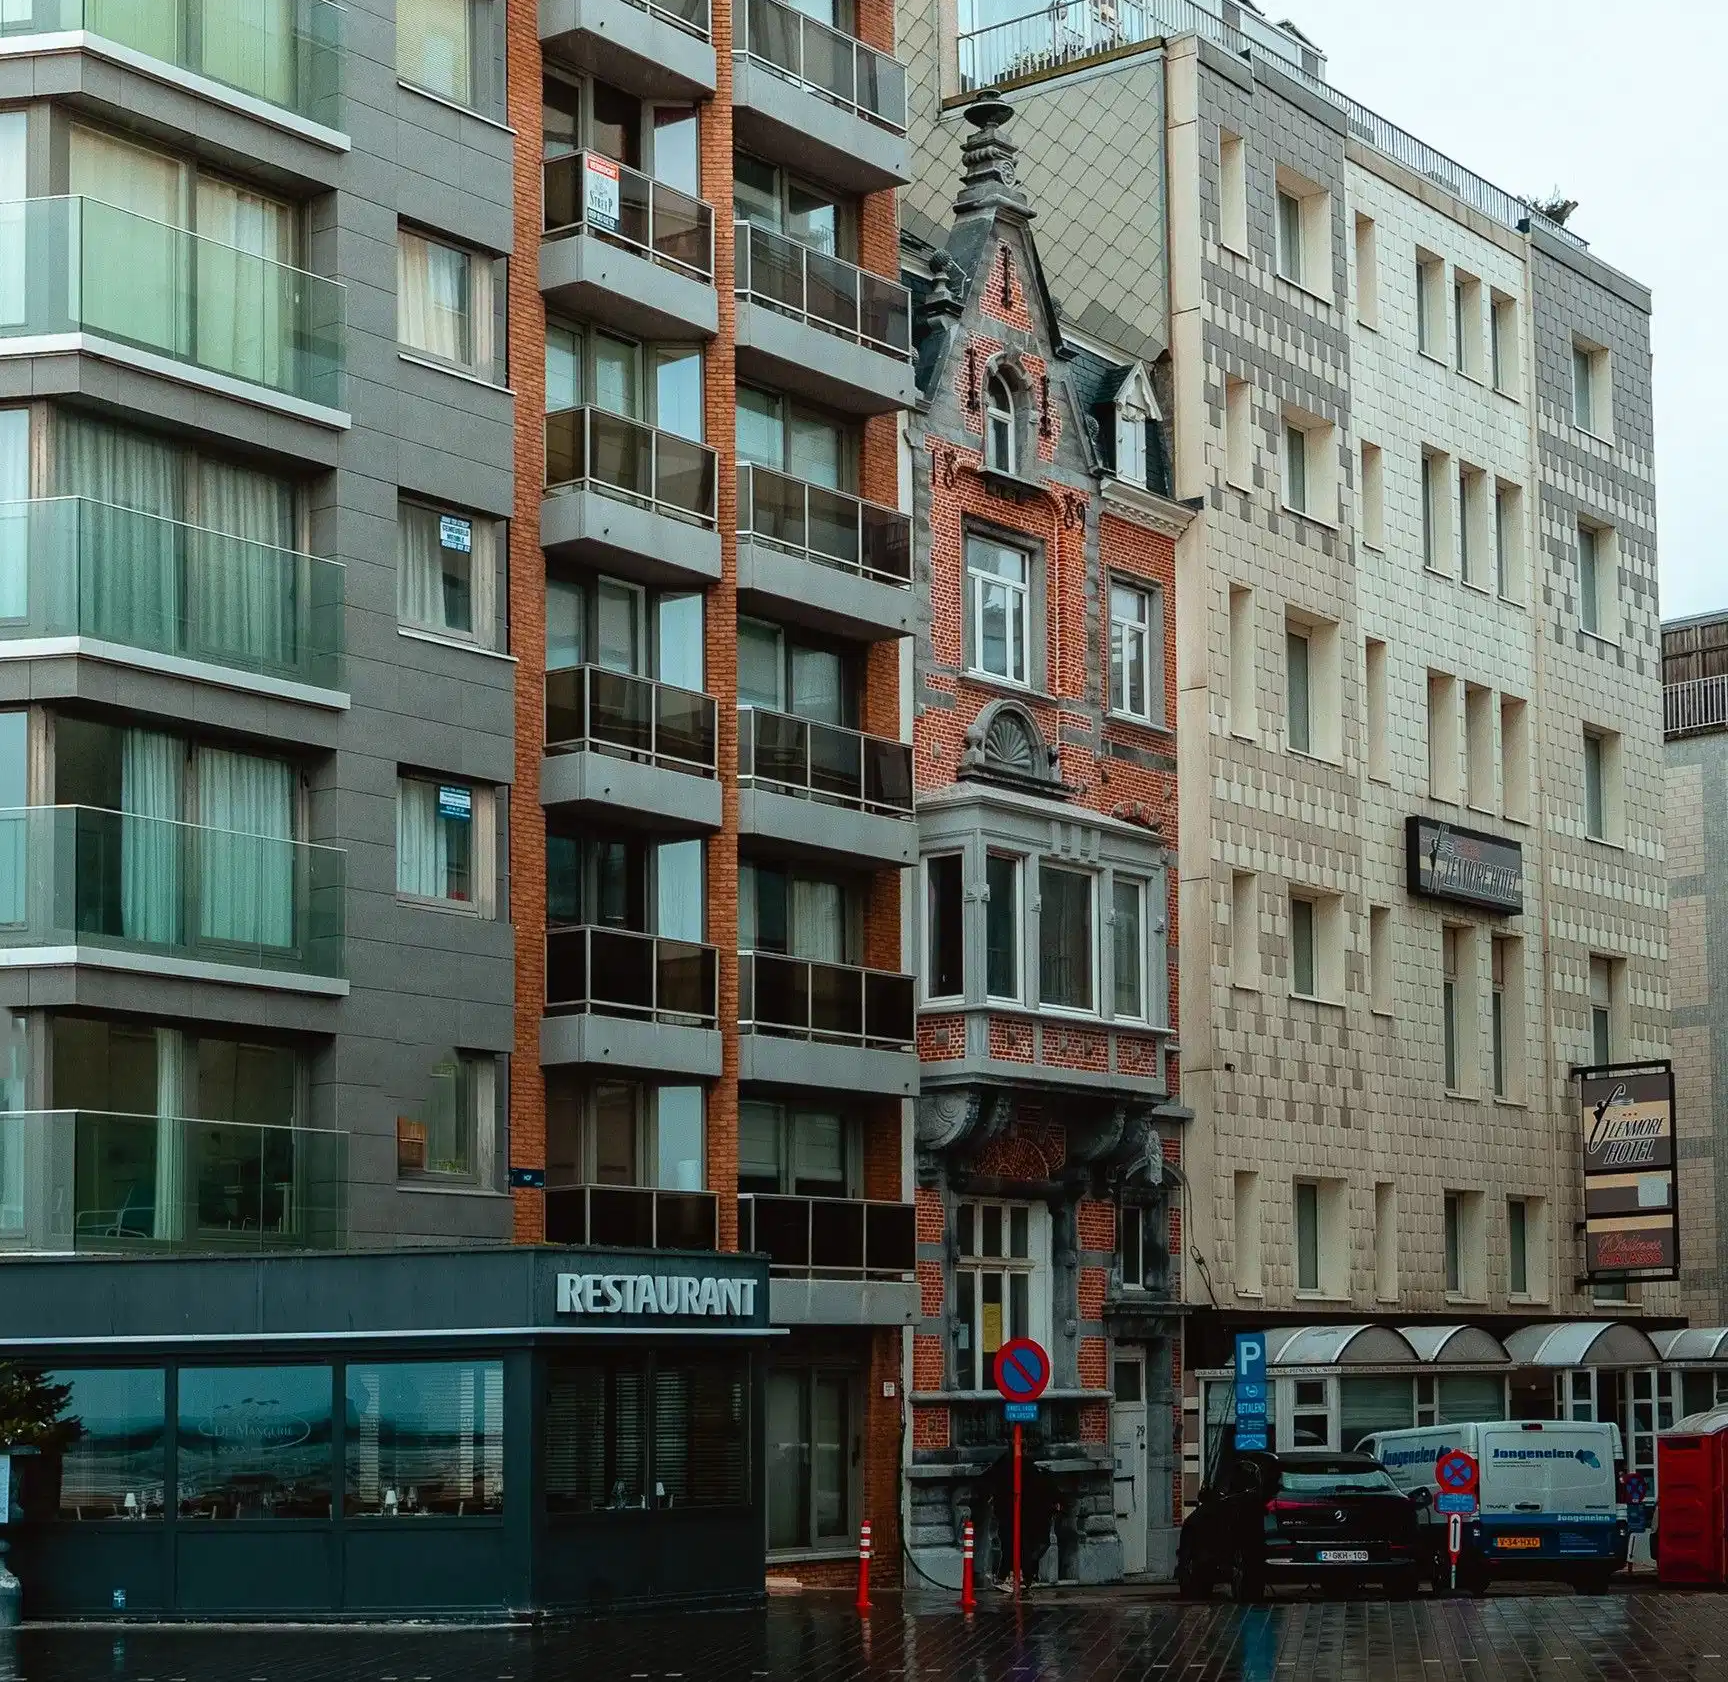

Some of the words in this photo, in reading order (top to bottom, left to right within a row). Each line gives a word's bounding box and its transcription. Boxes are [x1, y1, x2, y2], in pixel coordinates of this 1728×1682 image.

[1490, 867, 1519, 901] HOTEL
[1603, 1138, 1655, 1165] HOTEL
[1597, 1251, 1664, 1266] THALASSO
[556, 1273, 758, 1316] RESTAURANT
[1240, 1342, 1261, 1376] P
[1237, 1402, 1266, 1415] BETALEND
[1136, 1425, 1146, 1437] 29
[1492, 1448, 1574, 1460] Jongenelen
[1557, 1514, 1610, 1523] Jongenelen
